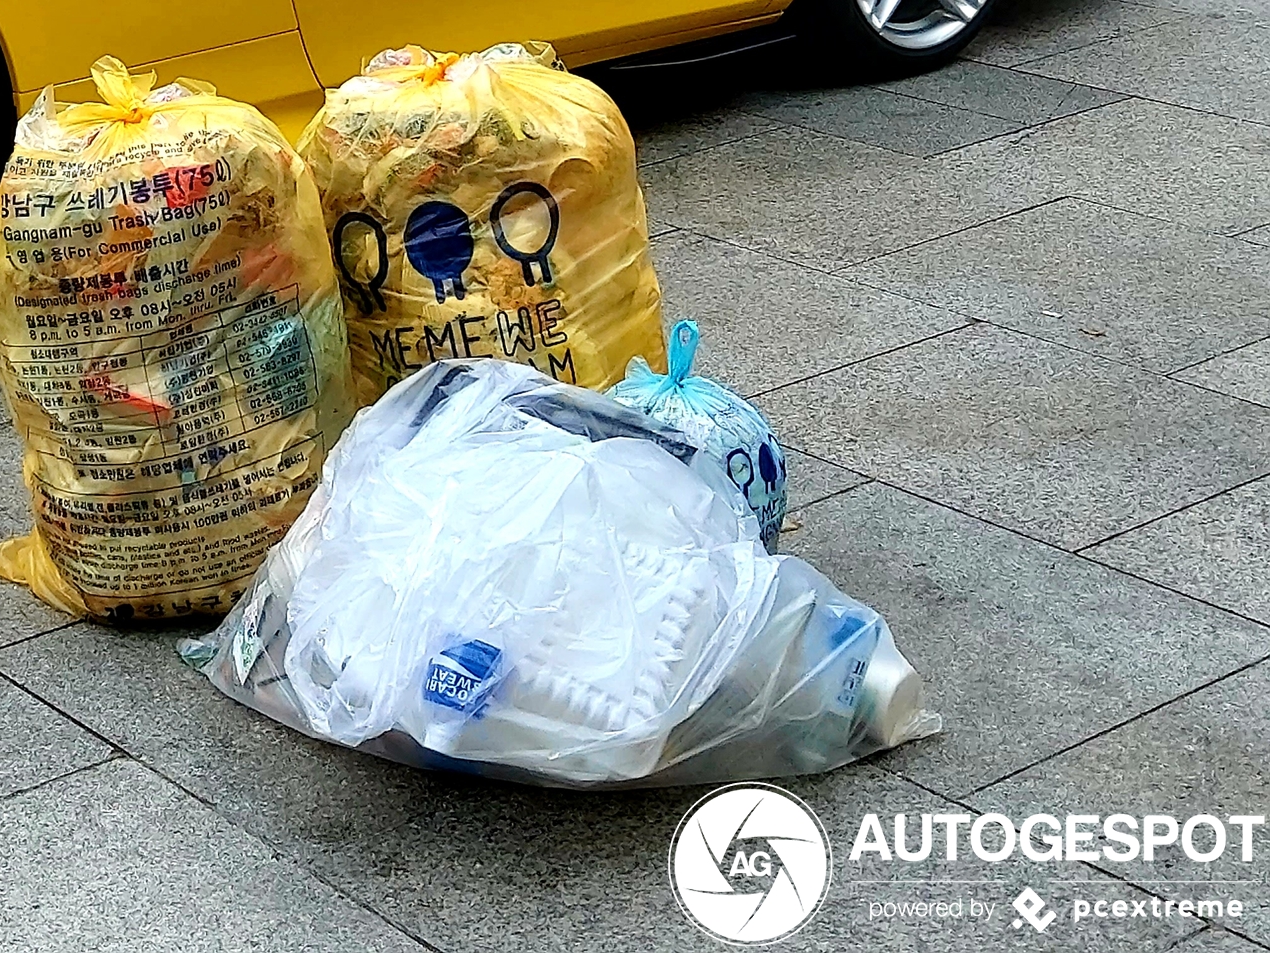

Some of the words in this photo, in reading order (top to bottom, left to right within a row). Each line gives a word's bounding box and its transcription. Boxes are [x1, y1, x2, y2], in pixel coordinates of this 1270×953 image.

[3, 221, 103, 244] Gangnam-gu
[108, 212, 154, 231] Trash
[98, 229, 186, 255] Commercial
[134, 259, 189, 283] 배출시간
[154, 268, 210, 292] discharge
[30, 330, 36, 341] 8
[66, 328, 78, 339] to
[83, 326, 91, 336] 5
[125, 319, 153, 332] from
[368, 326, 423, 372] ME
[424, 316, 493, 363] ME
[497, 299, 568, 357] WE
[426, 678, 470, 703] OCARI
